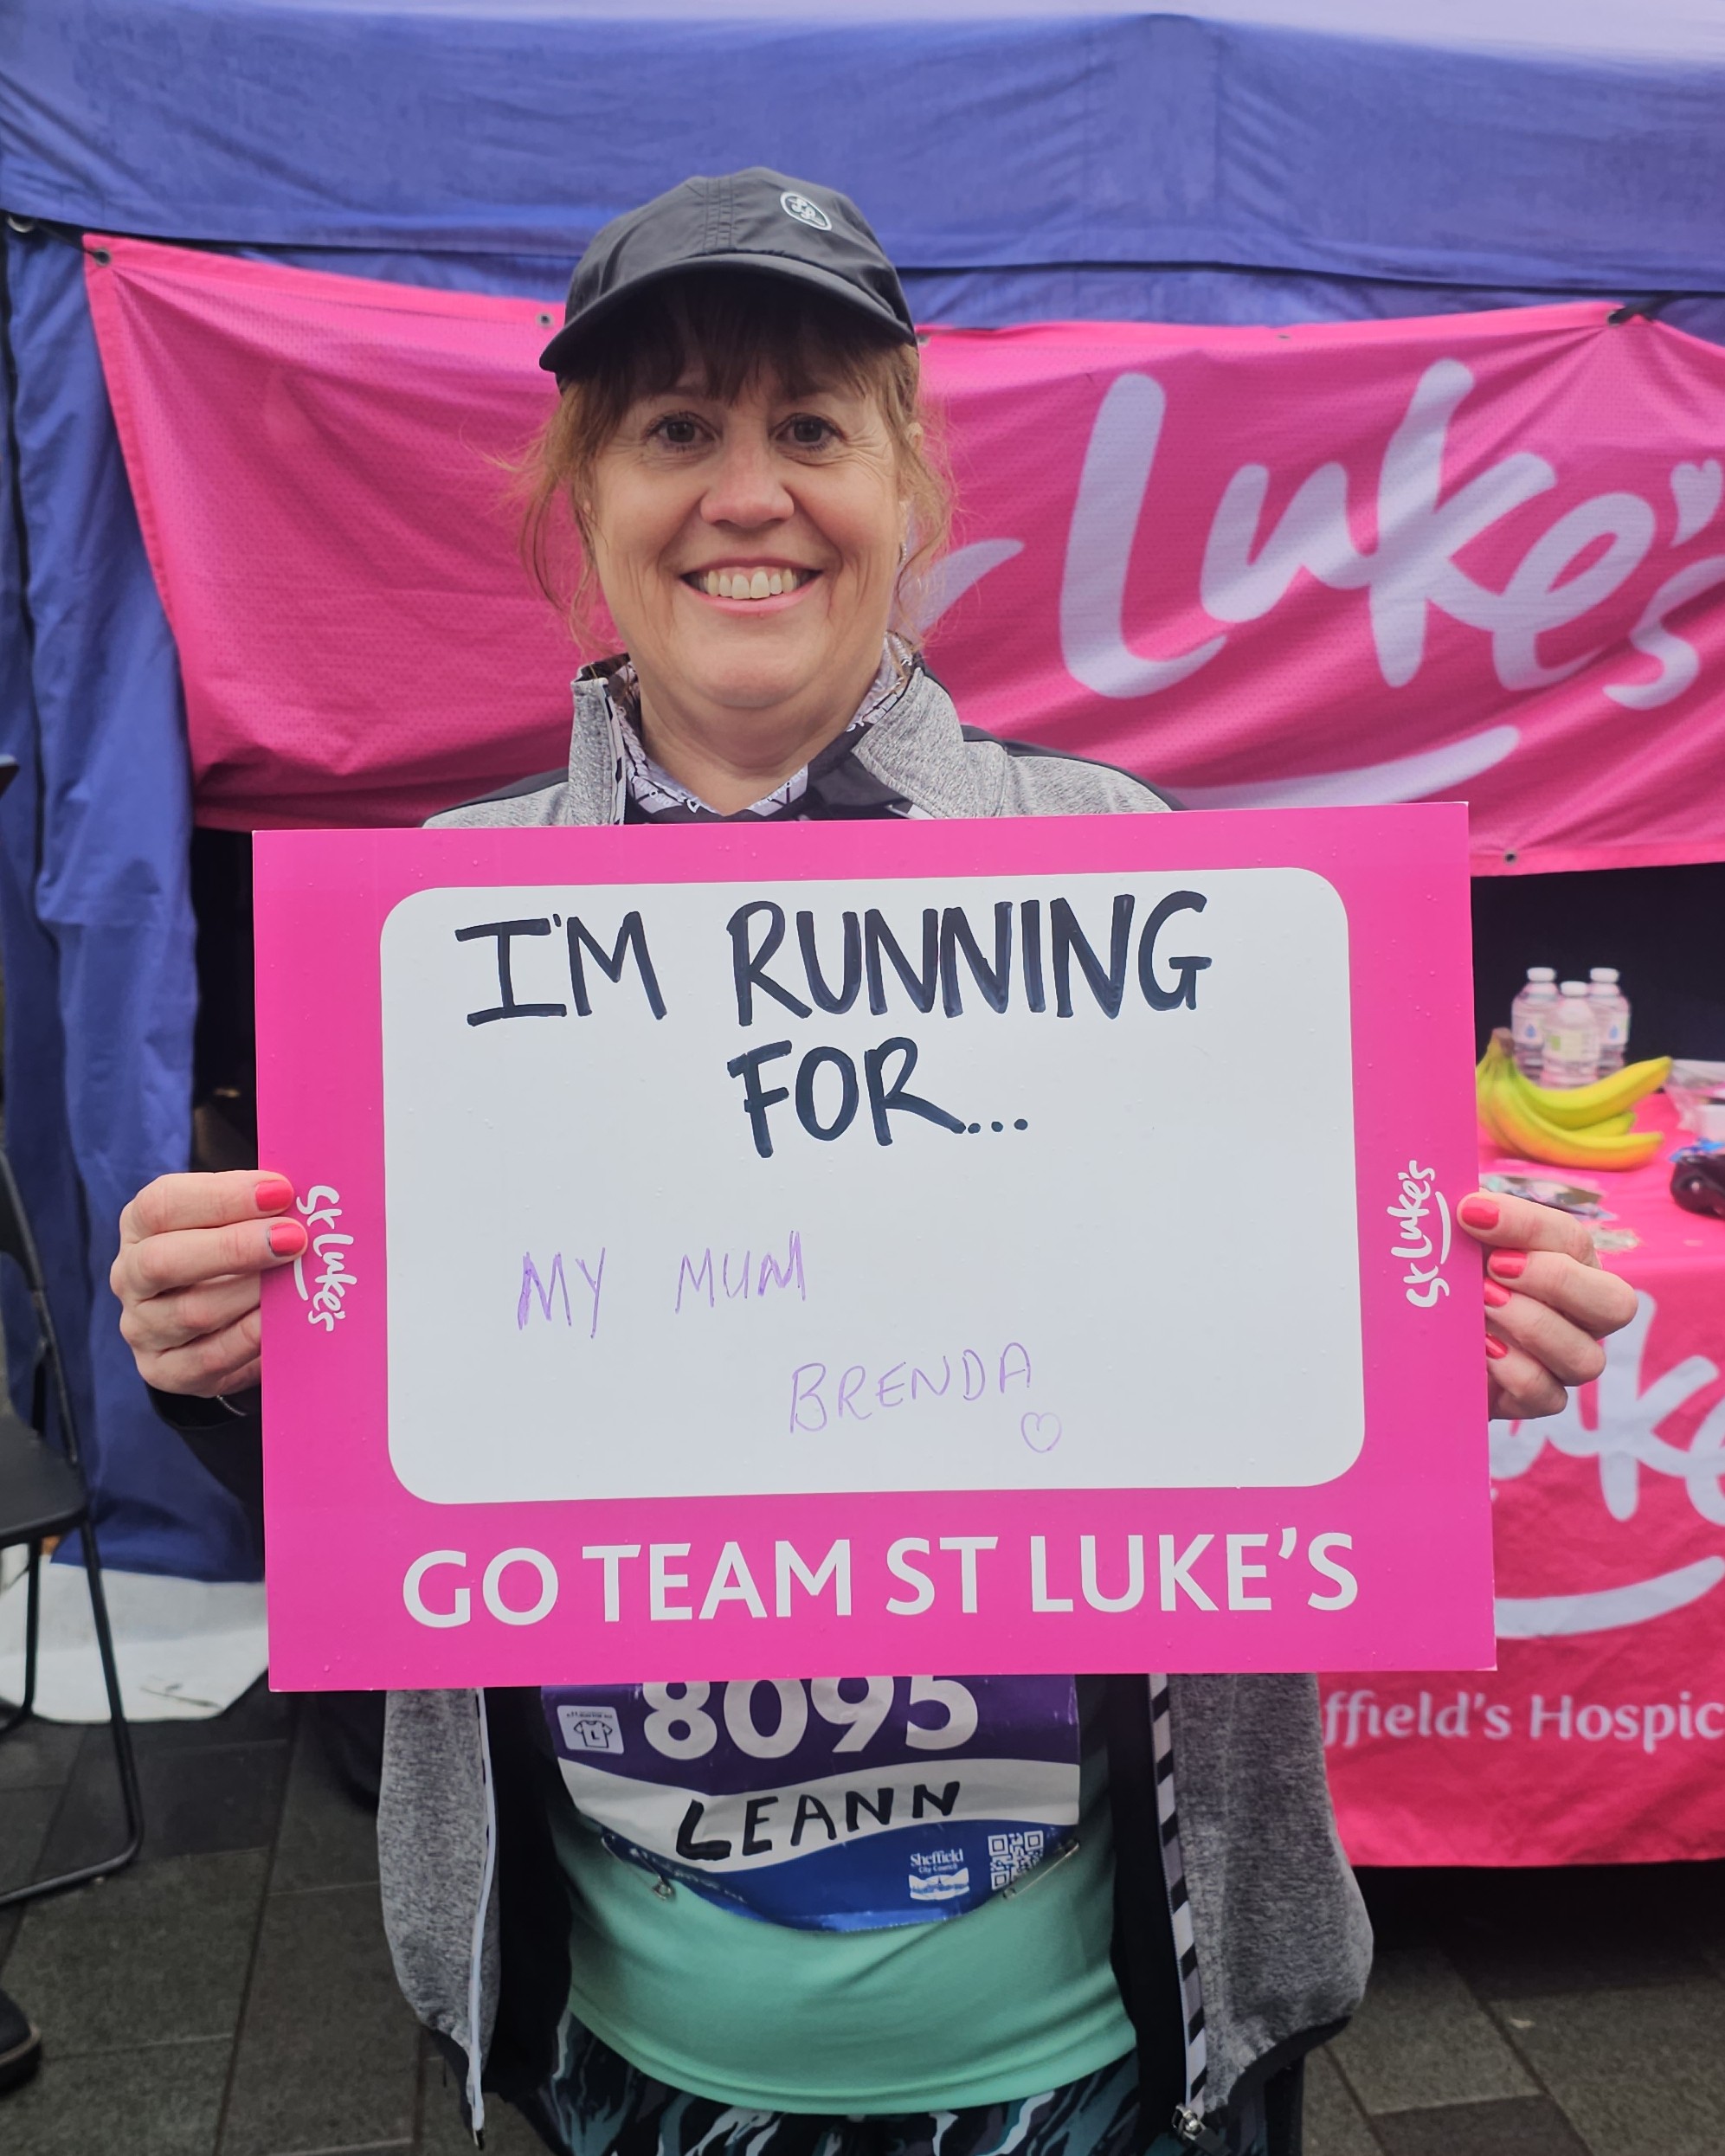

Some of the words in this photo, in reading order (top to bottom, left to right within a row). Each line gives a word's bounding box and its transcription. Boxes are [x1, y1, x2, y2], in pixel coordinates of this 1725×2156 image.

[1059, 357, 1725, 710] Luke's
[454, 910, 668, 1027] I'M
[726, 891, 1213, 1027] RUNNING
[726, 1036, 1030, 1159] FOR...
[517, 1247, 605, 1339] MY
[675, 1230, 806, 1314] MUM
[789, 1342, 1031, 1433] BRENDA
[402, 1548, 559, 1628] GO
[583, 1538, 853, 1623] TEAM
[885, 1535, 998, 1616] ST
[1029, 1528, 1358, 1612] LUKE'S
[642, 1676, 978, 1760] 8095
[675, 1781, 961, 1861] LEANN
[911, 1849, 963, 1866] Sheffield
